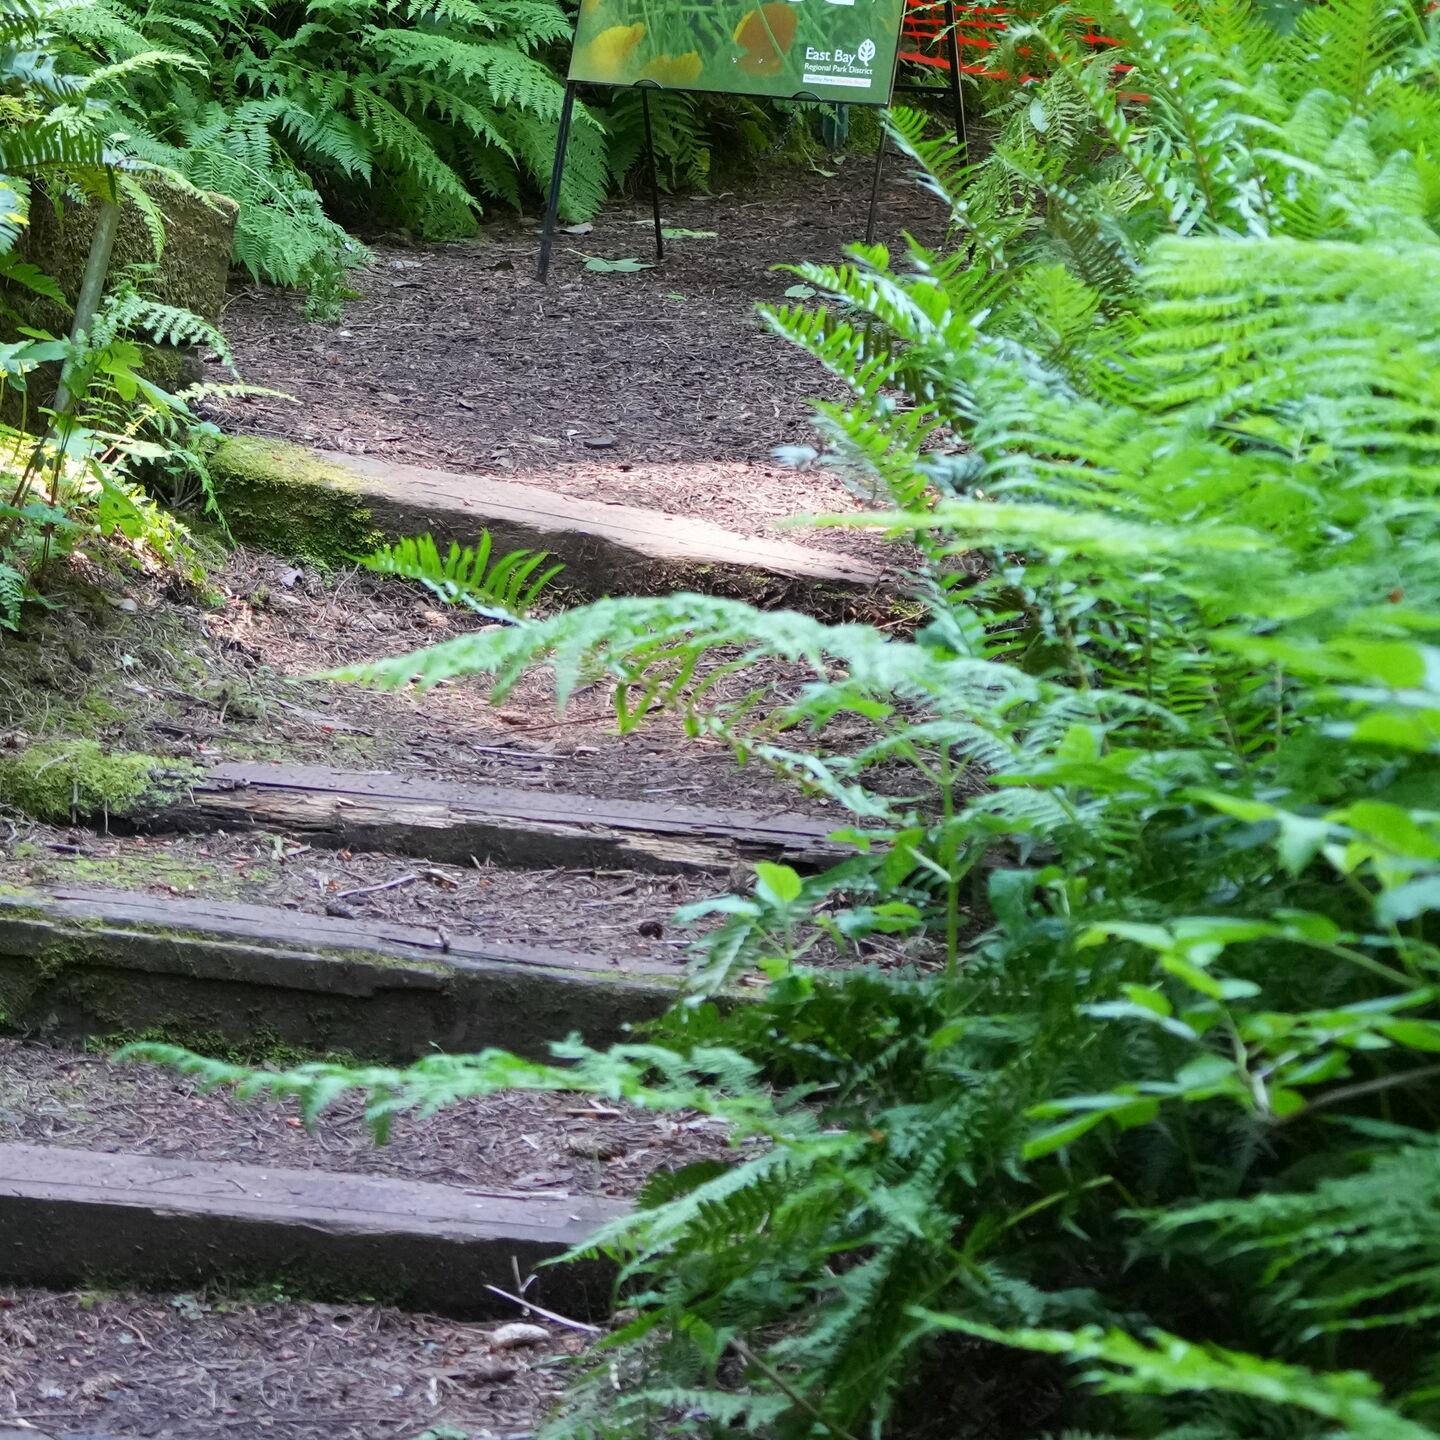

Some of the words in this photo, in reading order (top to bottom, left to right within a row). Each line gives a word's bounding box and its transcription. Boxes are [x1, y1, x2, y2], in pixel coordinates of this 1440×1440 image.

[805, 46, 831, 61] East
[834, 49, 856, 67] Bay
[804, 62, 832, 72] Regional
[832, 65, 847, 73] Park
[848, 65, 873, 75] District
